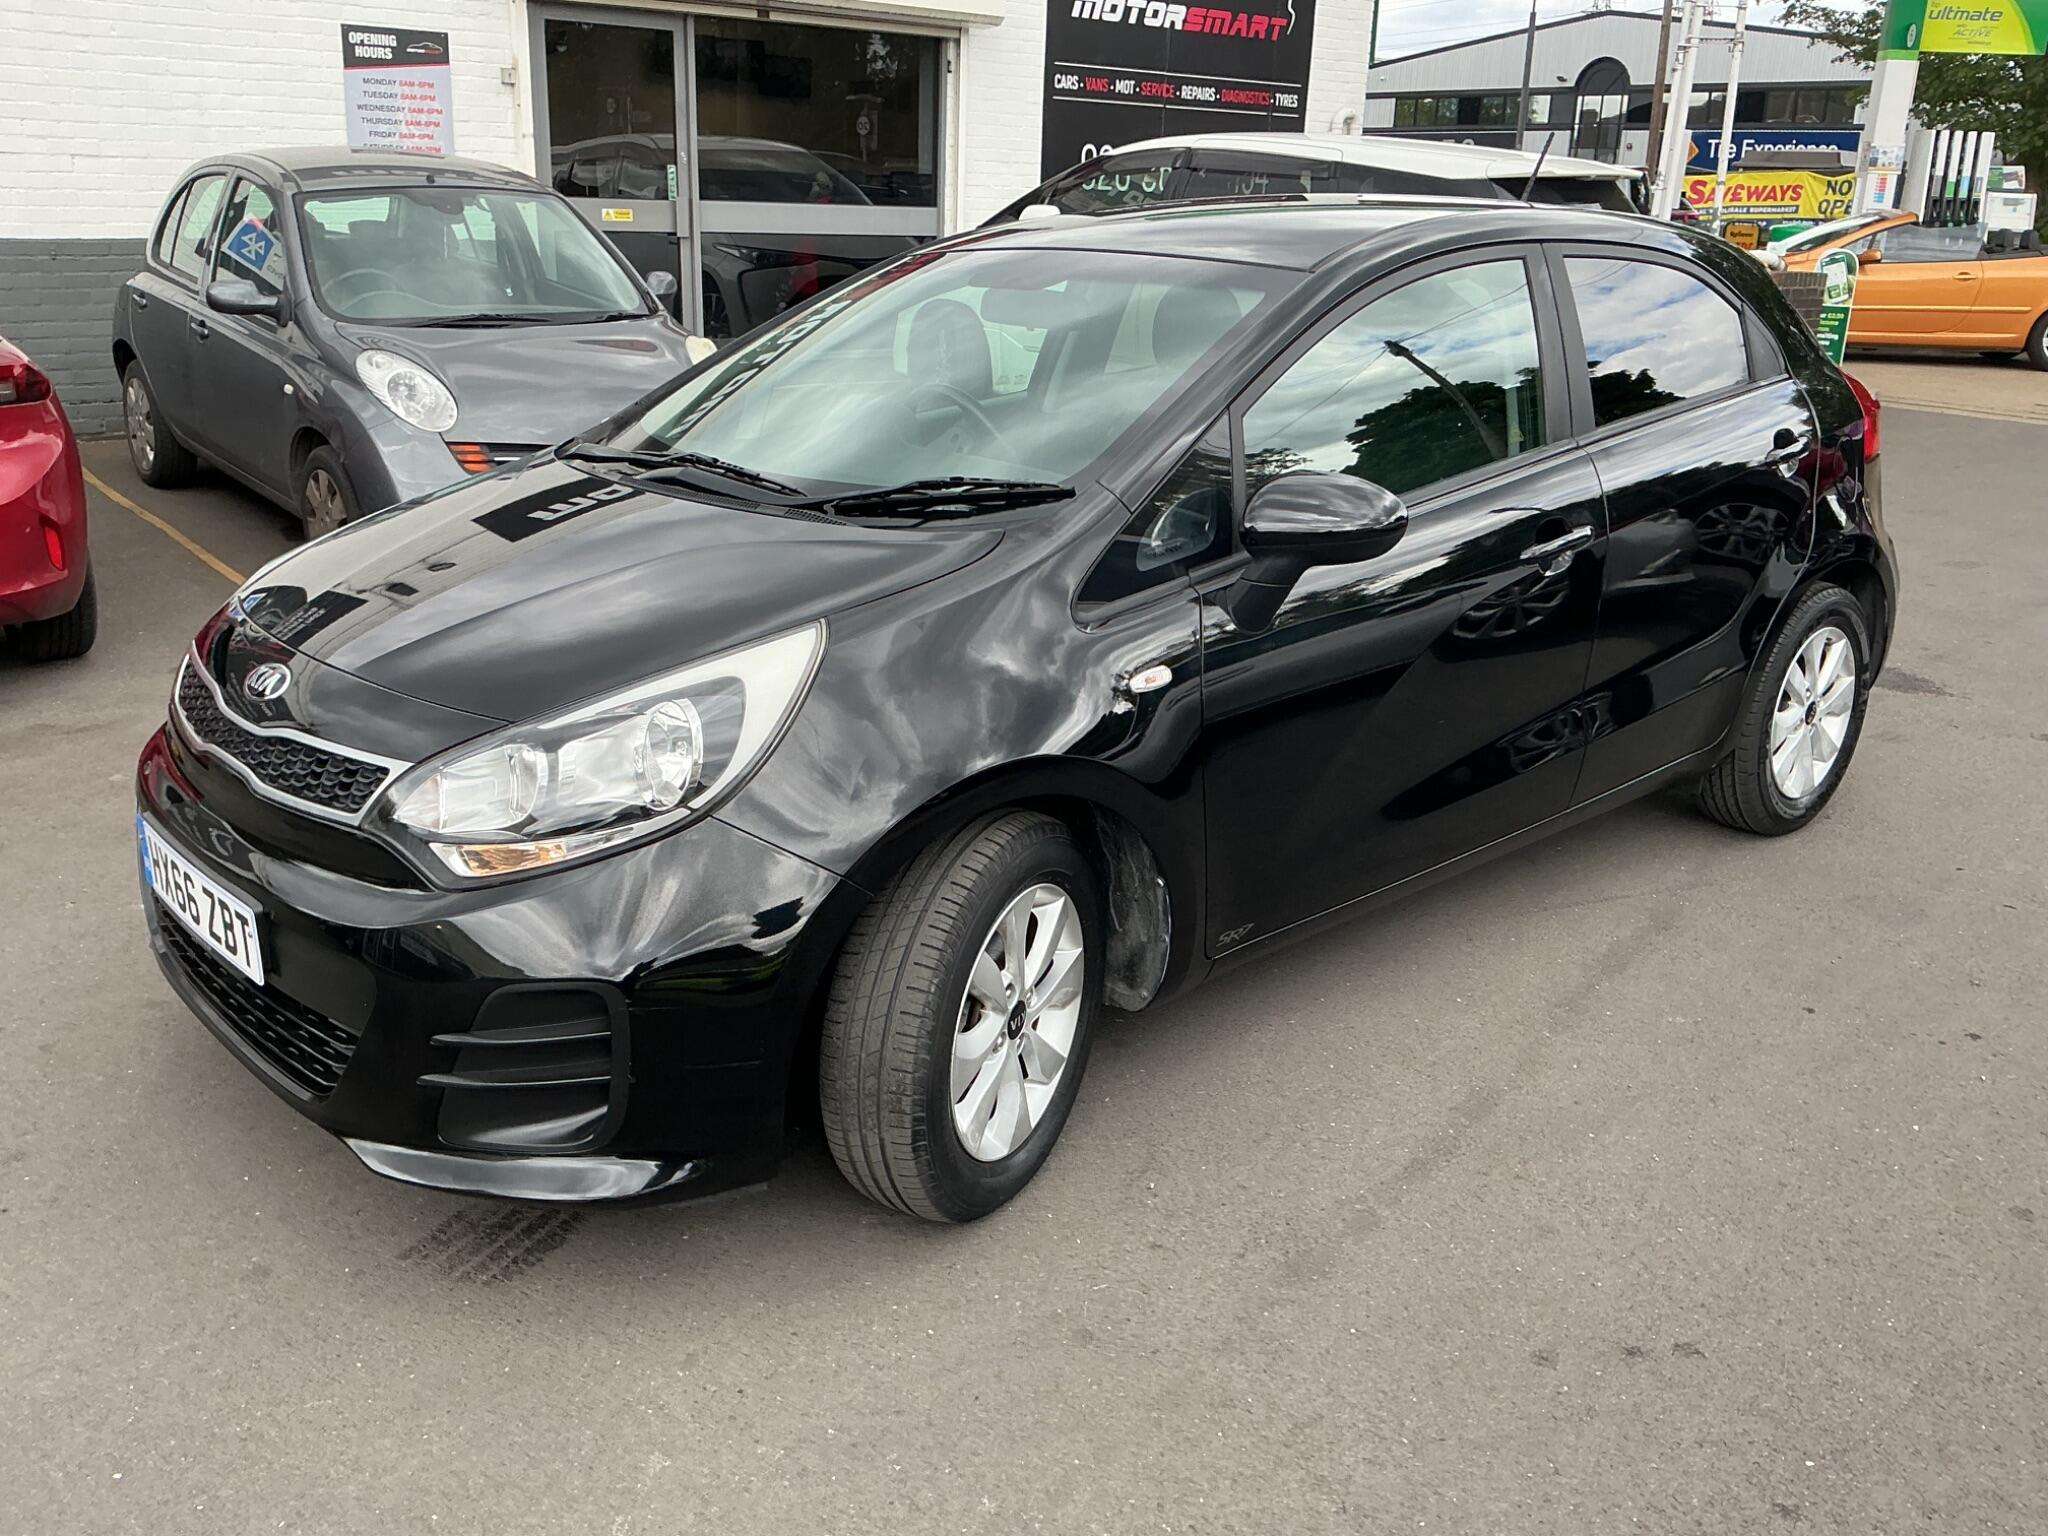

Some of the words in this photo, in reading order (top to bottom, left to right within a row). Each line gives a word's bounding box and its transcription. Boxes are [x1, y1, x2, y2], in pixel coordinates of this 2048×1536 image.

[1928, 5, 2004, 21] ultimate
[1071, 0, 1288, 42] MOTORSMART
[348, 31, 397, 47] OPENING
[354, 45, 393, 60] HOURS
[362, 77, 397, 87] MONDAY
[362, 91, 398, 100] TUESDAY
[1054, 74, 1079, 90] CARS
[1085, 77, 1109, 93] VANS
[1115, 80, 1135, 94] MOT
[1140, 82, 1175, 98] SERVICE
[1181, 85, 1216, 101] REPAIRS
[1221, 89, 1270, 105] DIAGNOSTICS
[1275, 93, 1299, 108] TYRES
[356, 104, 406, 113] WEDNESDAY
[361, 117, 403, 127] THURSDAY
[368, 130, 397, 139] FRIDAY
[149, 834, 201, 926] HX66
[202, 886, 252, 969] ZBT
